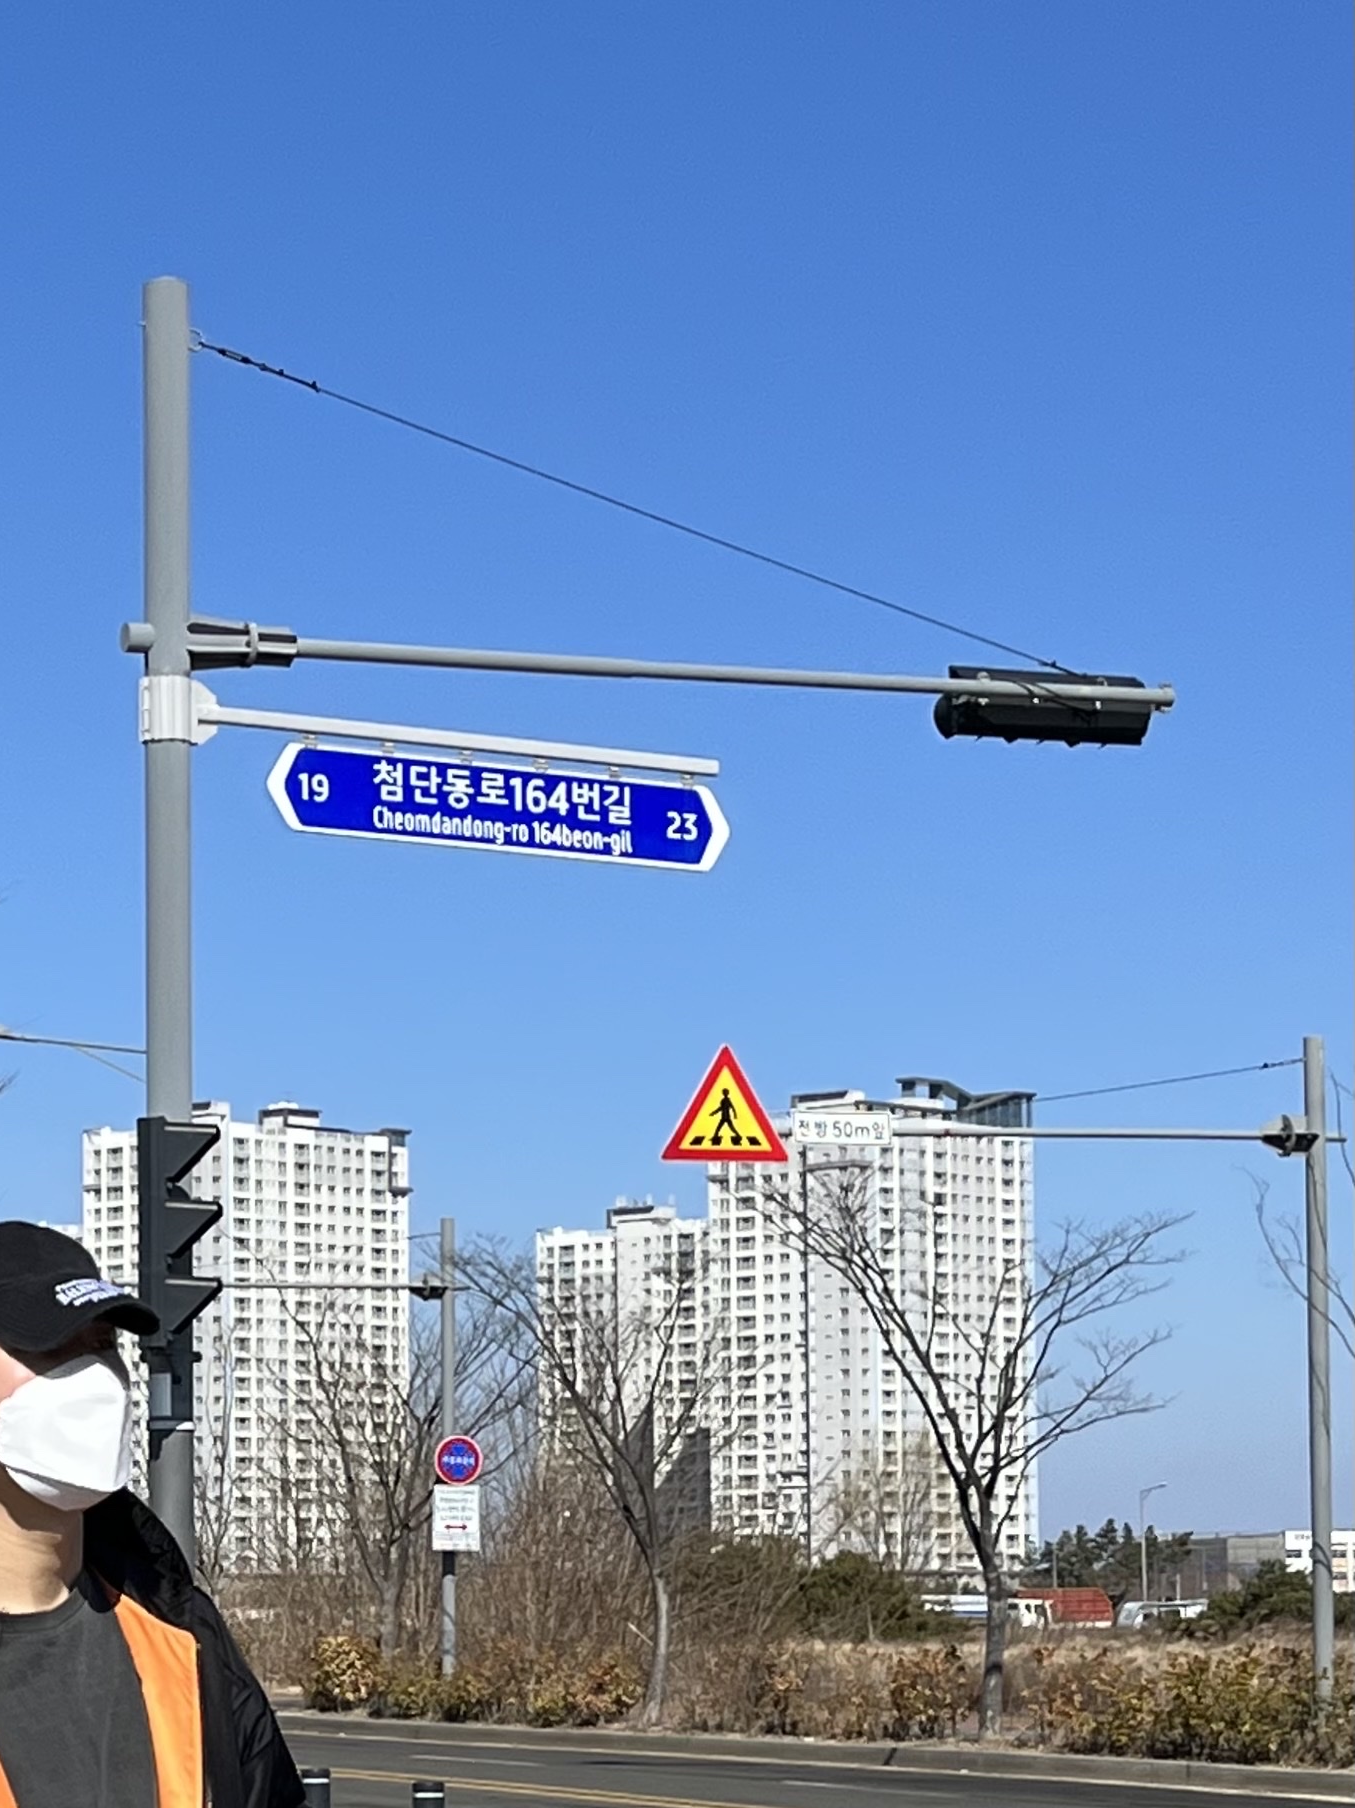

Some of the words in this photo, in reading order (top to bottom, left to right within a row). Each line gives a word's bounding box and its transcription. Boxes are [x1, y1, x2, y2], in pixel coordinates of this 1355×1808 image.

[297, 772, 330, 802] 19
[372, 759, 632, 825] 첨단동로164번길
[372, 805, 529, 845] Cheomdandong-ro
[531, 820, 633, 856] 164beon-gil
[666, 811, 698, 841] 23
